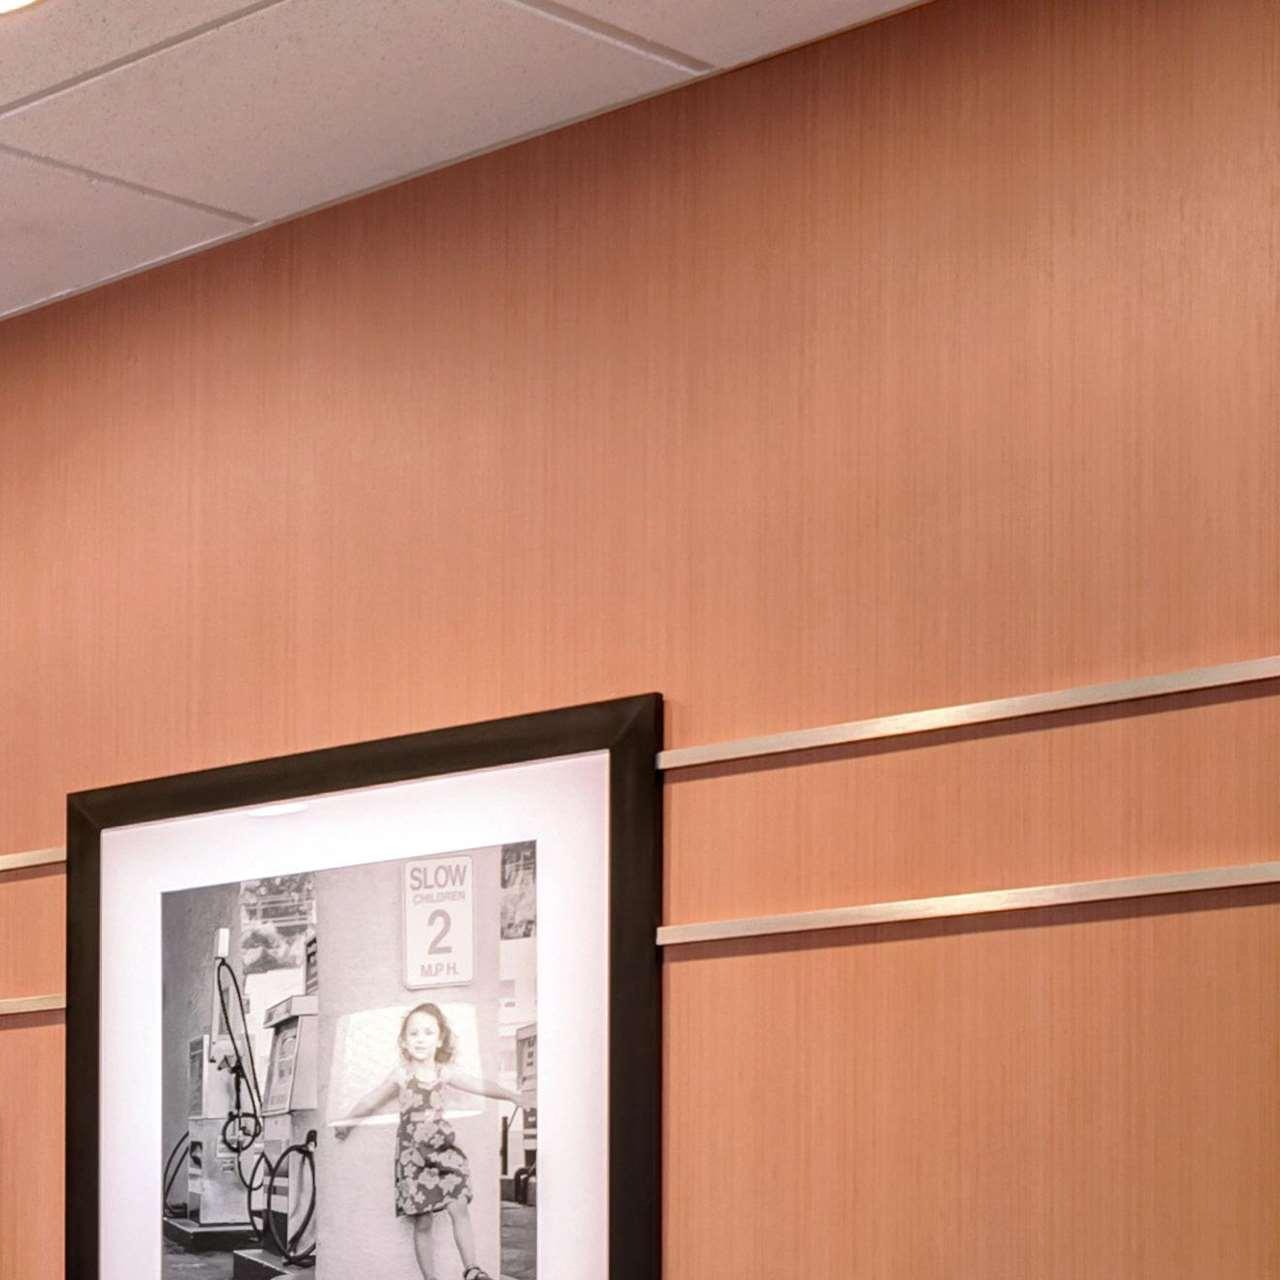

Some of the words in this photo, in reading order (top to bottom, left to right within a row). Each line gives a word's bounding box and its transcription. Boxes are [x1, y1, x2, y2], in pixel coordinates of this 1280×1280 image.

[409, 864, 467, 891] SLOW
[411, 891, 466, 905] CHILDREN
[427, 908, 453, 955] 2
